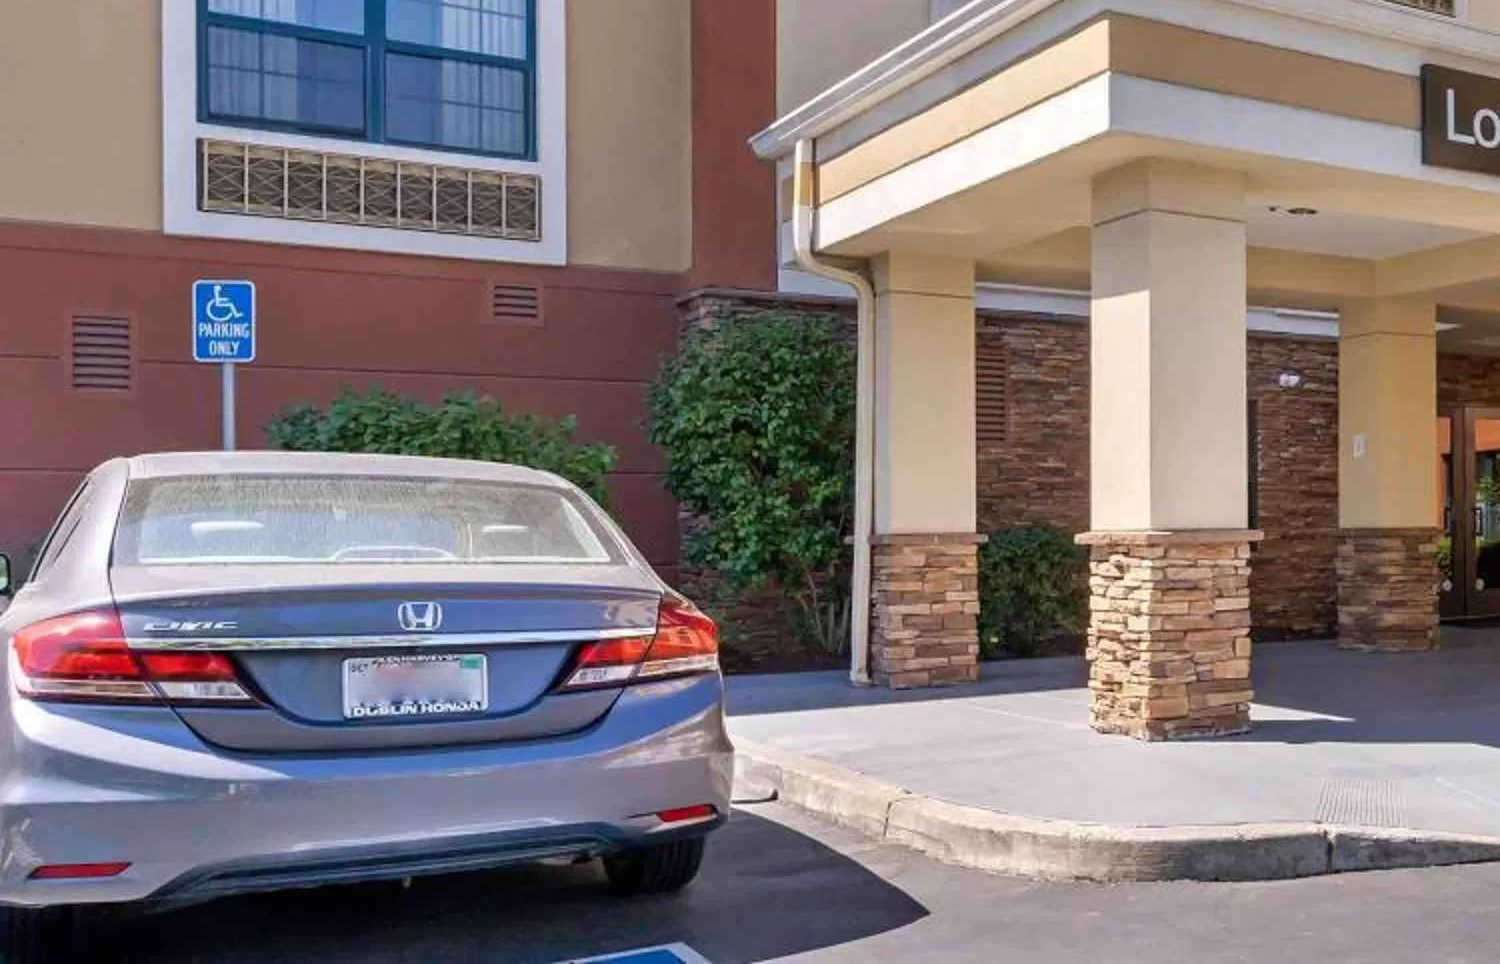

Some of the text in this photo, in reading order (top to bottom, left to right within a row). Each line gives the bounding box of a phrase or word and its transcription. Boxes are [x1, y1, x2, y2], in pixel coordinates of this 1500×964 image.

[198, 322, 250, 339] PARKING
[208, 340, 241, 356] ONLY
[421, 700, 480, 714] HONDA
